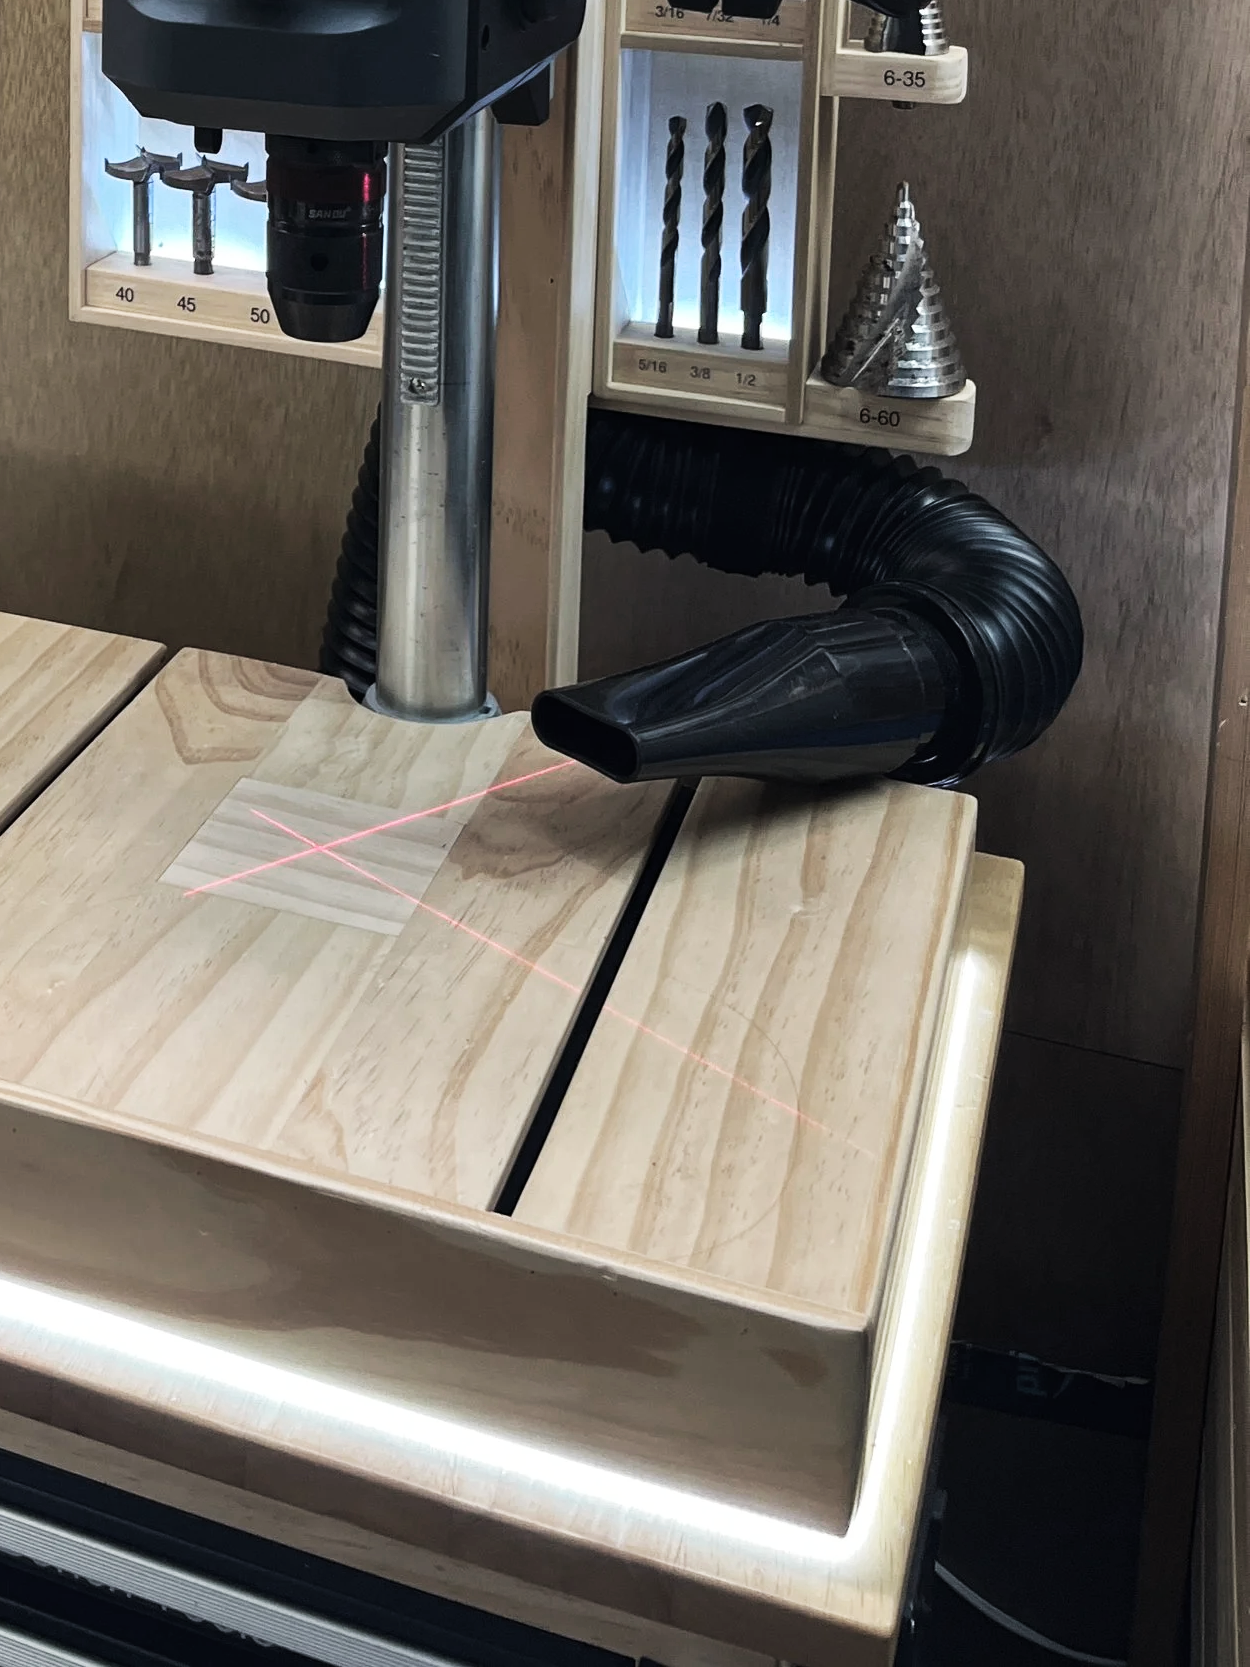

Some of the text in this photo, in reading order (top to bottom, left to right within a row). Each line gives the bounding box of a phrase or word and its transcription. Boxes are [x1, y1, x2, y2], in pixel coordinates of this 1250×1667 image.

[655, 5, 685, 19] 3/16
[884, 69, 926, 88] 6-35
[115, 286, 270, 324] 40 45 50
[638, 359, 756, 387] 5/16 3/8 1/2
[859, 407, 900, 427] 6-60
